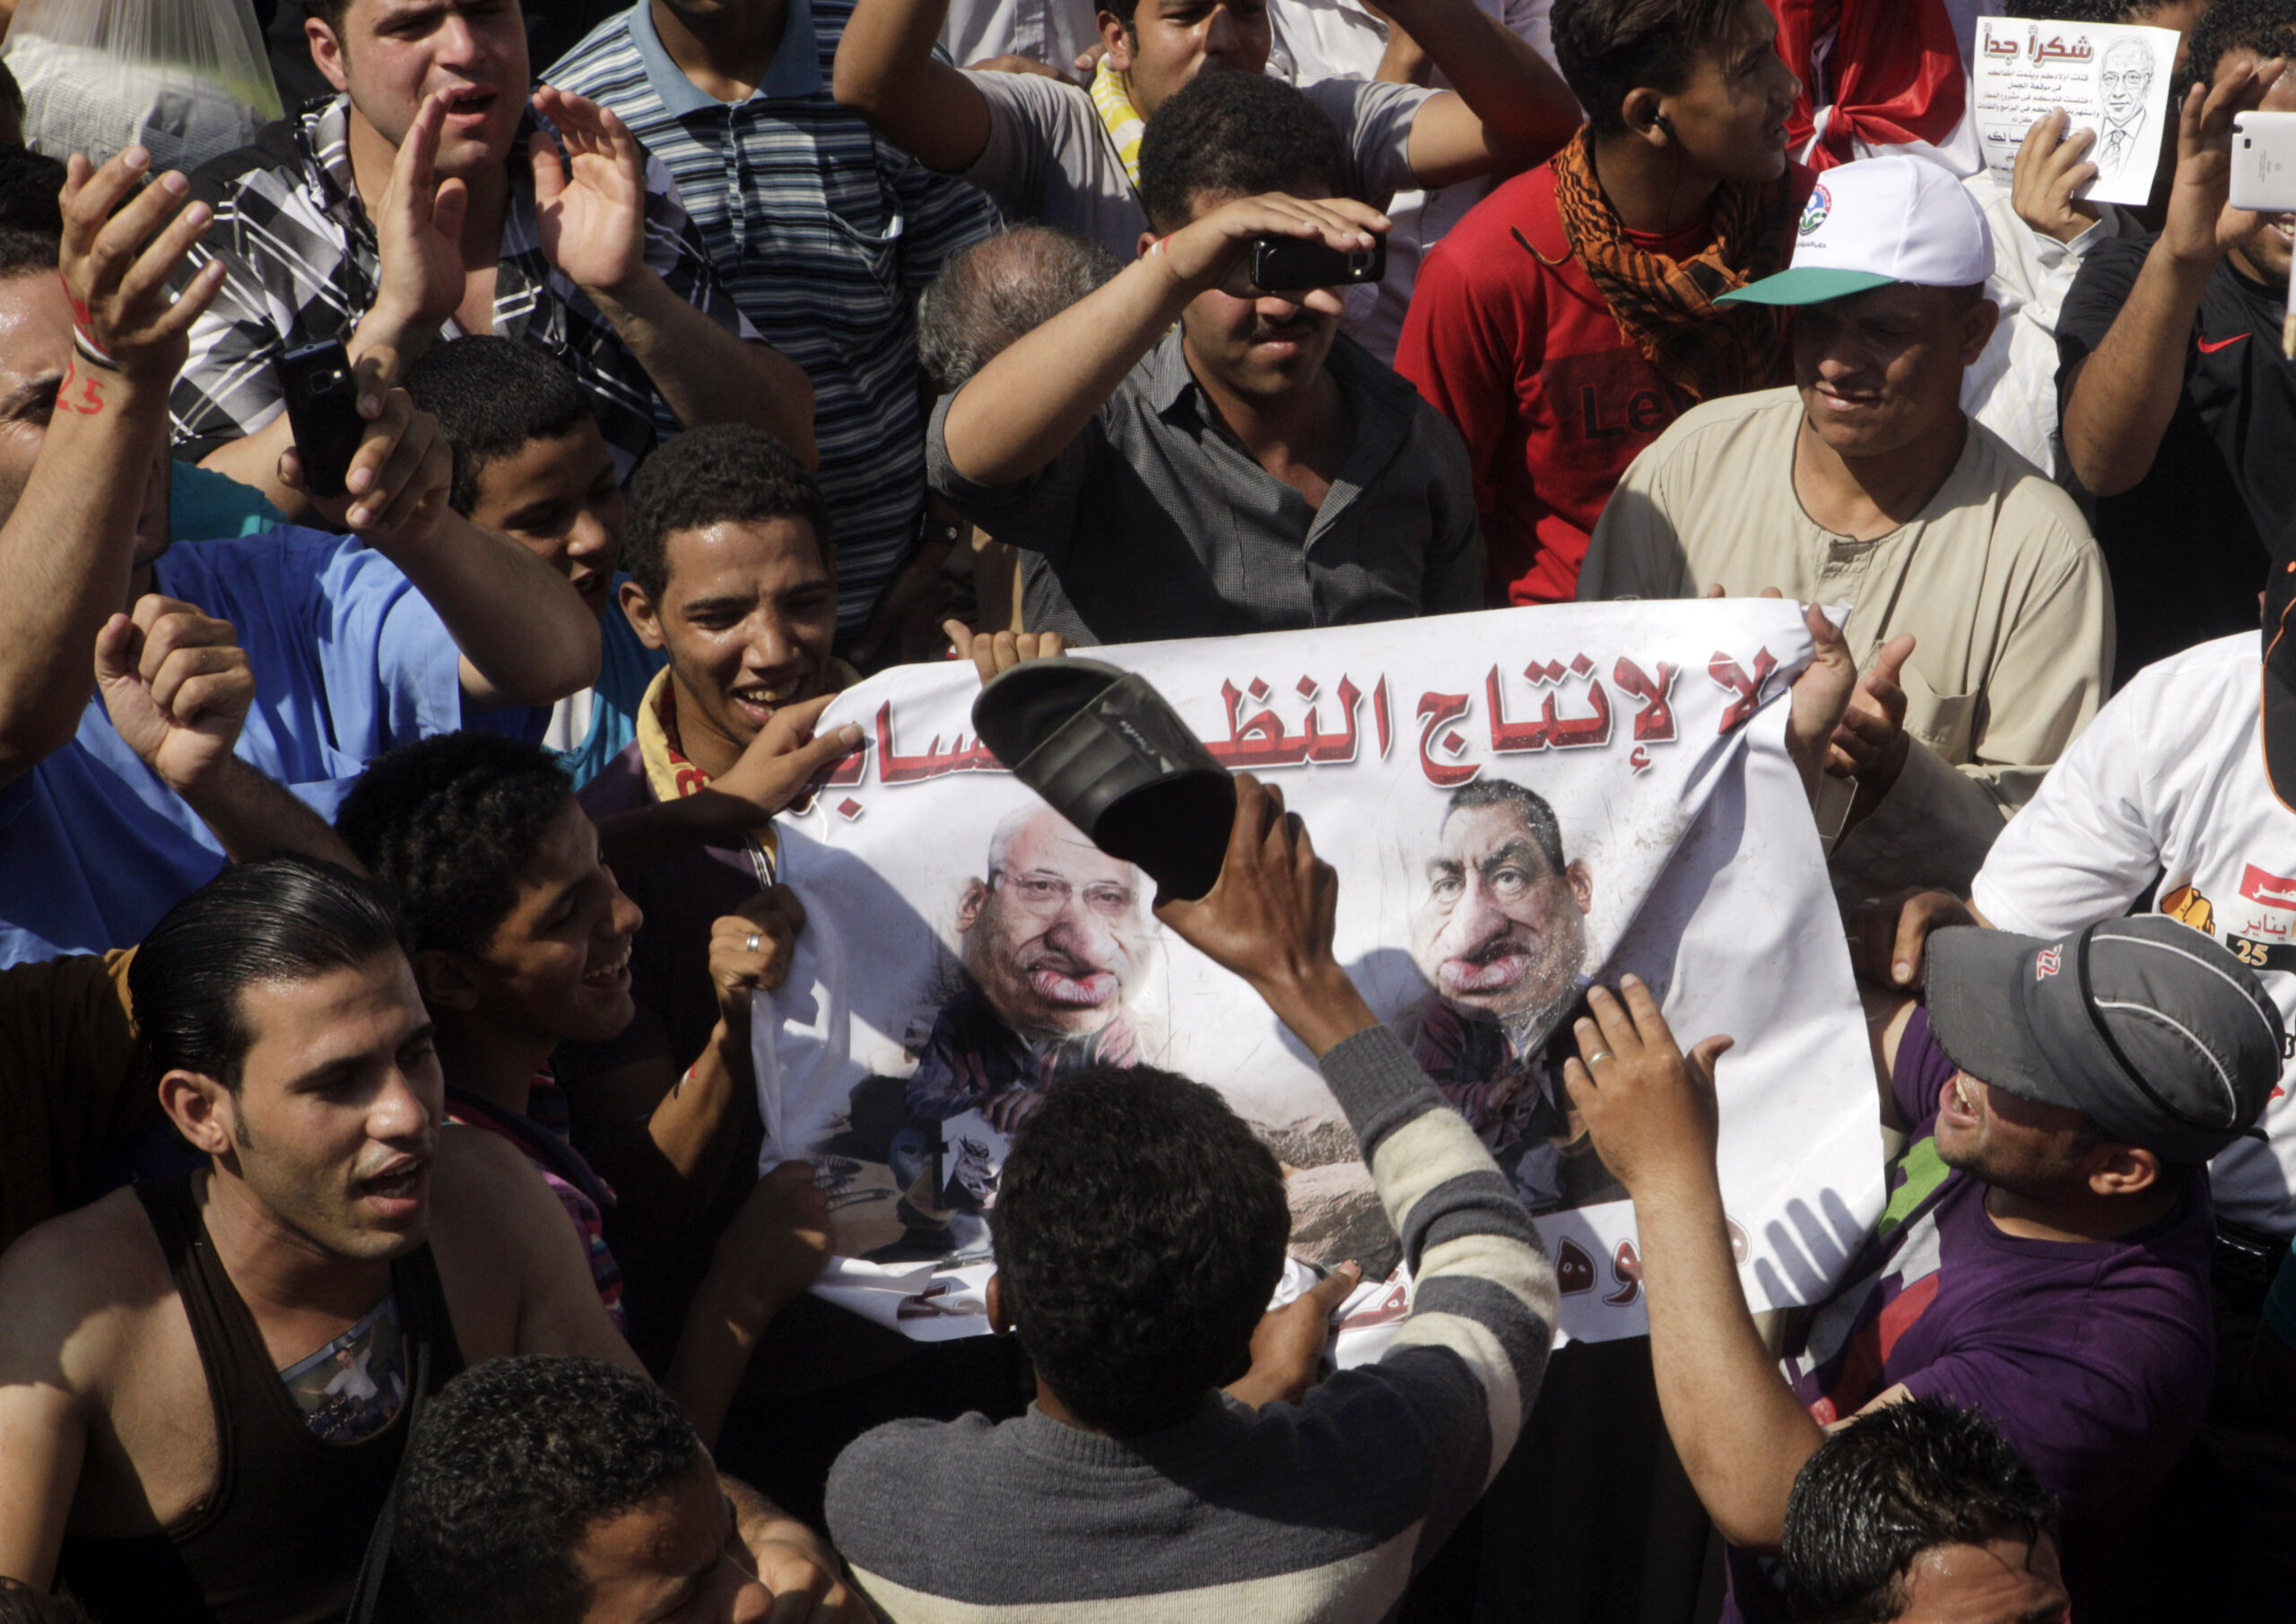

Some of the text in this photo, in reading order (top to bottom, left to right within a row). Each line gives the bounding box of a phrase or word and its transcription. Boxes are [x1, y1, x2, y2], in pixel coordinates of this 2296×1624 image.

[56, 360, 106, 414] 25
[1707, 645, 1780, 737] لا
[1203, 672, 1392, 770] النظ
[2237, 939, 2269, 967] 25
[2239, 913, 2287, 941] يناير
